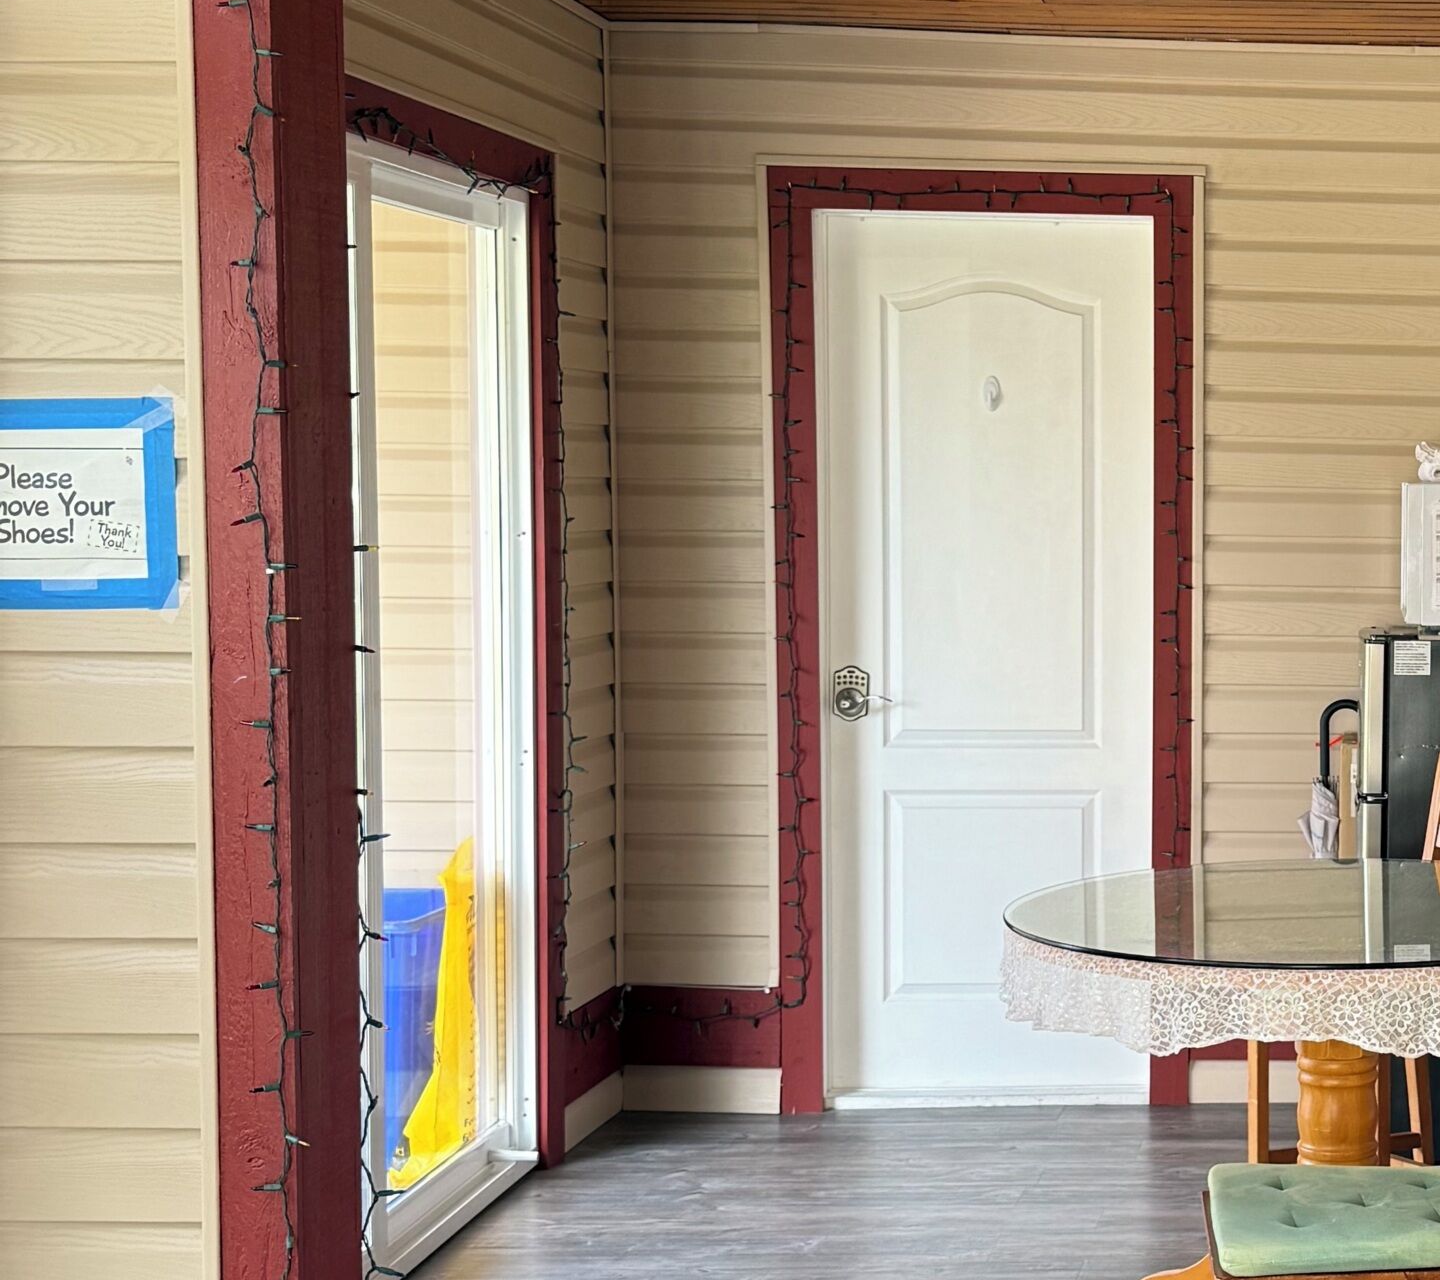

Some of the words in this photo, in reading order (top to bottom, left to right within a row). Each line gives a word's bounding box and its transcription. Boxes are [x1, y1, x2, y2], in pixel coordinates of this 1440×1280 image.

[0, 463, 73, 489] Please
[58, 490, 116, 517] Your
[0, 518, 74, 544] Shoes!
[97, 522, 132, 538] Thank
[101, 535, 125, 549] You!
